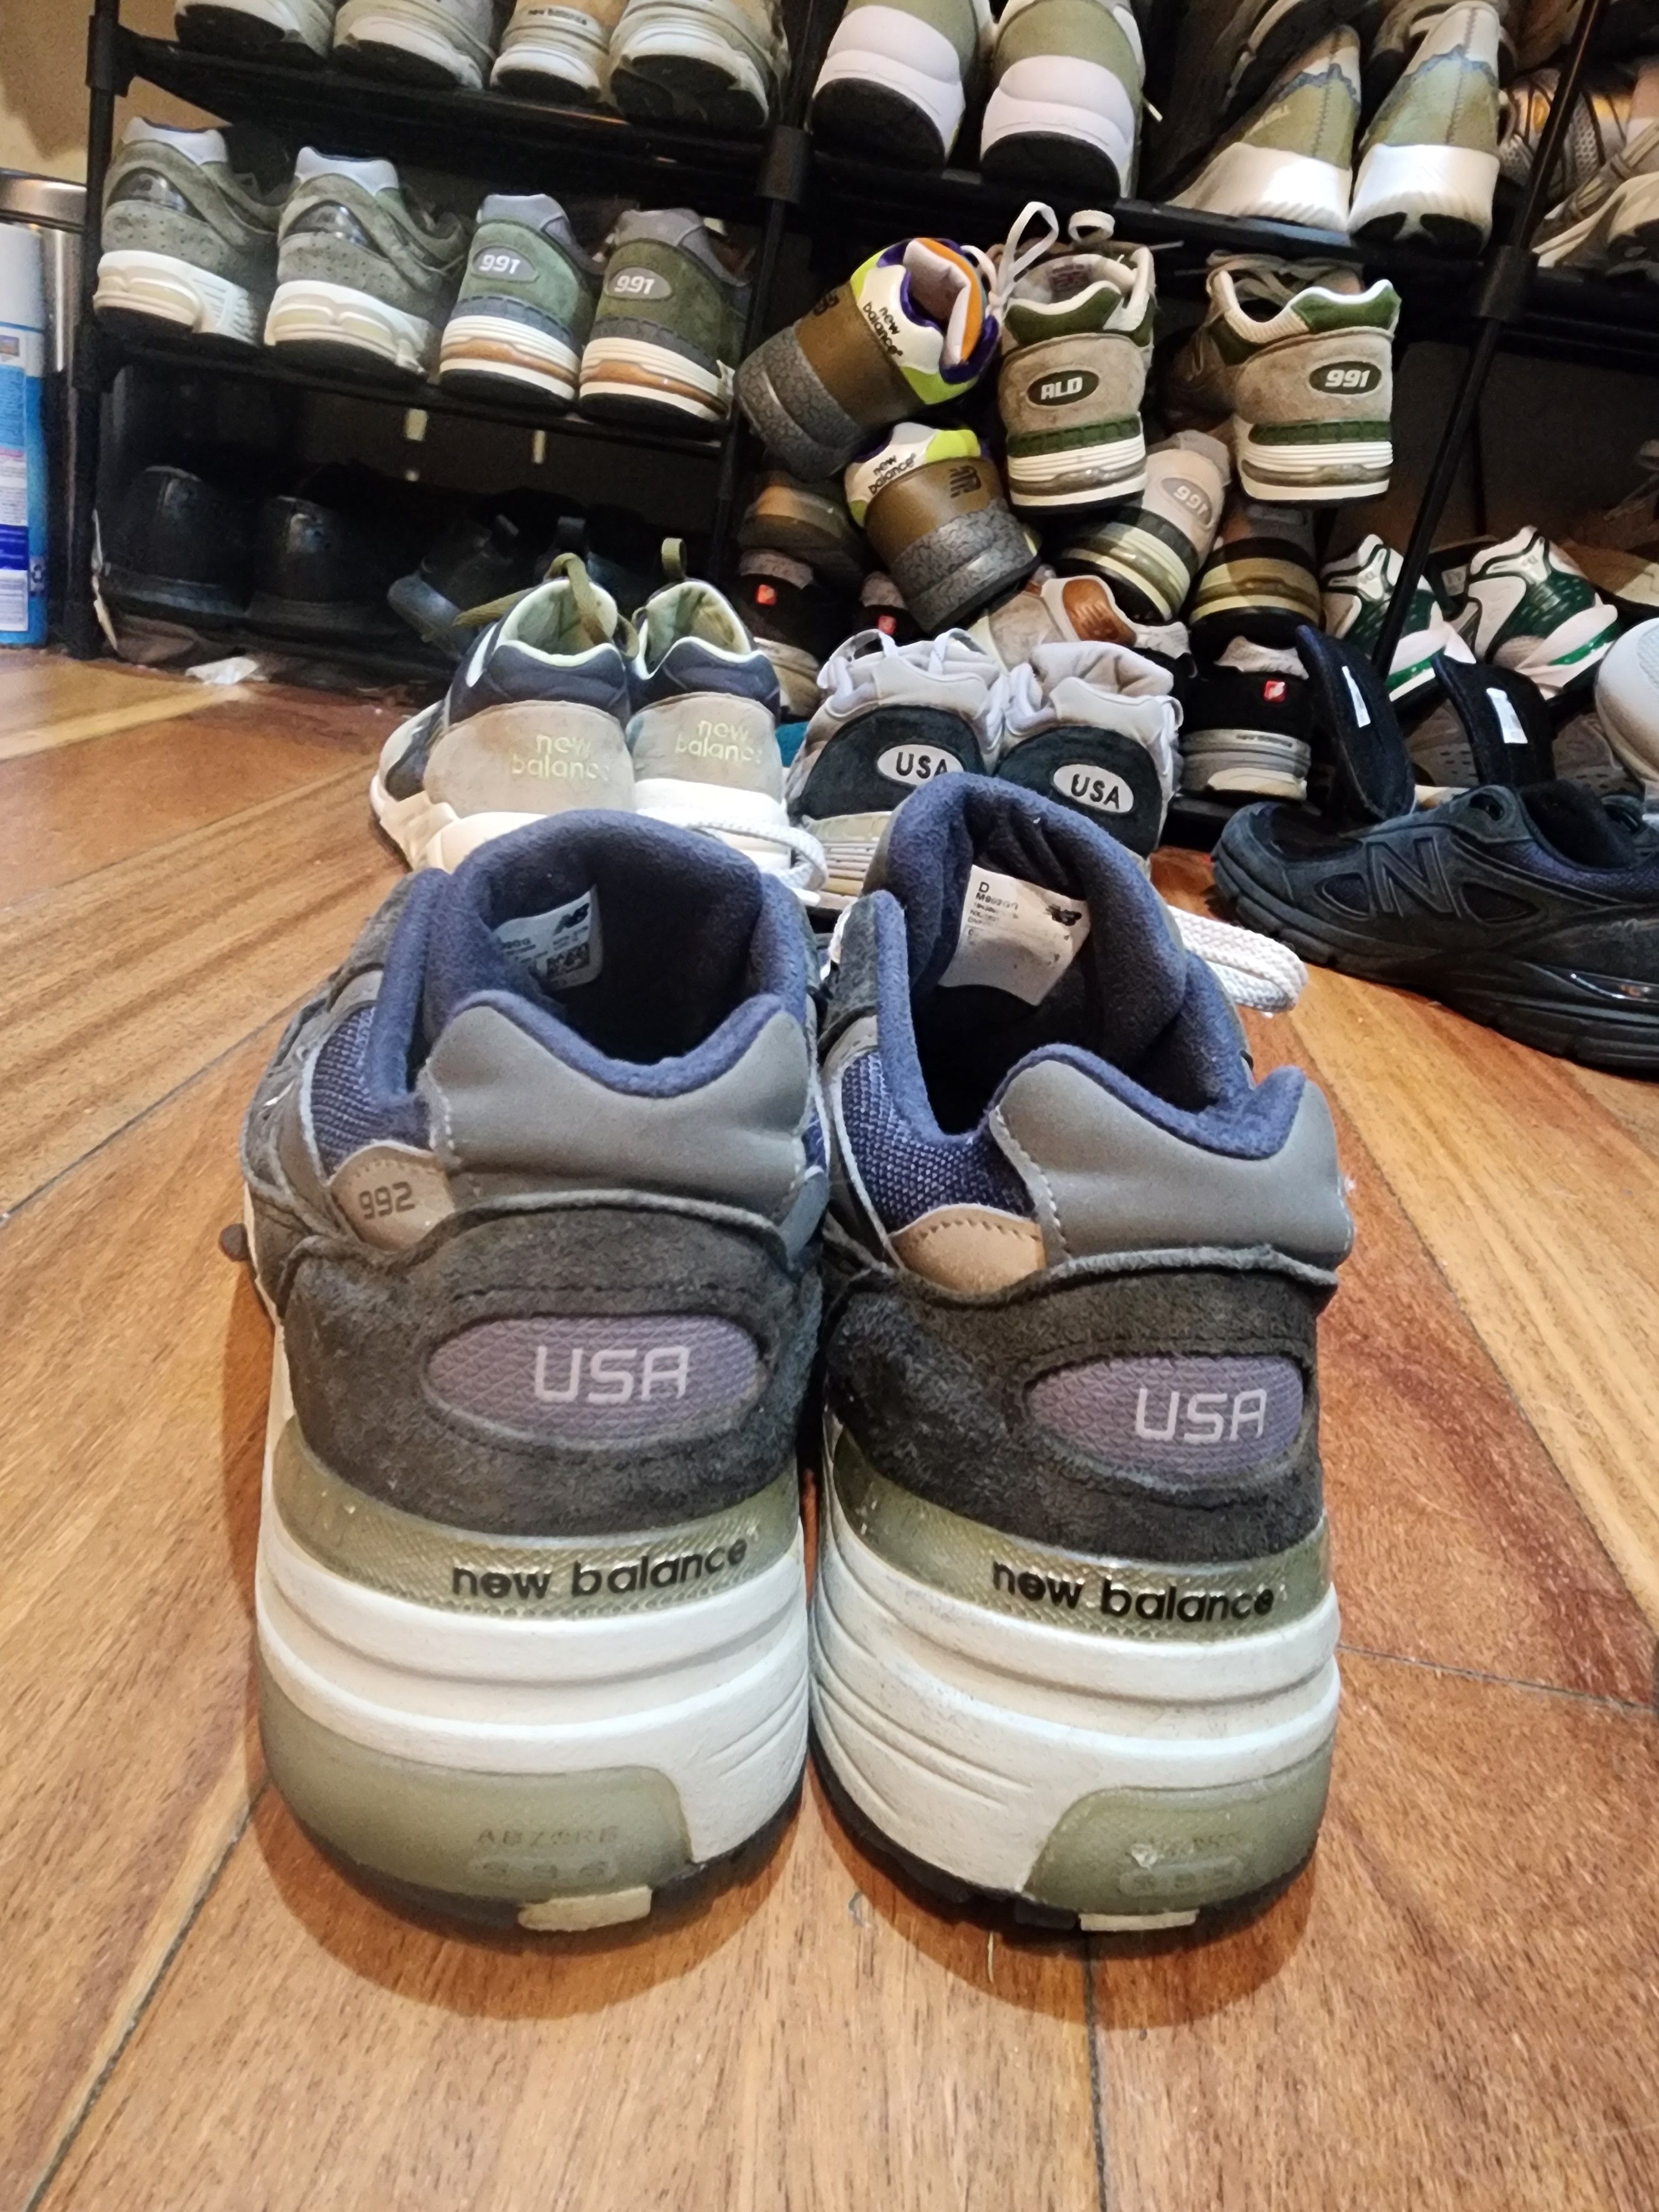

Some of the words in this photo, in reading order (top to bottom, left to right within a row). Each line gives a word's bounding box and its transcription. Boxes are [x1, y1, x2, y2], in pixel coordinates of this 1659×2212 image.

[479, 255, 520, 274] 991
[614, 275, 654, 295] 991
[1041, 377, 1083, 400] ALD
[1324, 369, 1371, 388] 991
[1173, 486, 1208, 515] 991
[697, 720, 750, 742] new
[536, 734, 593, 759] new
[896, 752, 948, 779] USA
[1070, 774, 1120, 809] USA
[978, 881, 990, 894] D
[359, 1181, 415, 1220] 992
[535, 1345, 691, 1405] USA
[1135, 1388, 1267, 1444] USA
[452, 1566, 552, 1599] new
[571, 1538, 748, 1597] balance
[993, 1561, 1083, 1610] new
[1100, 1577, 1274, 1623] balance
